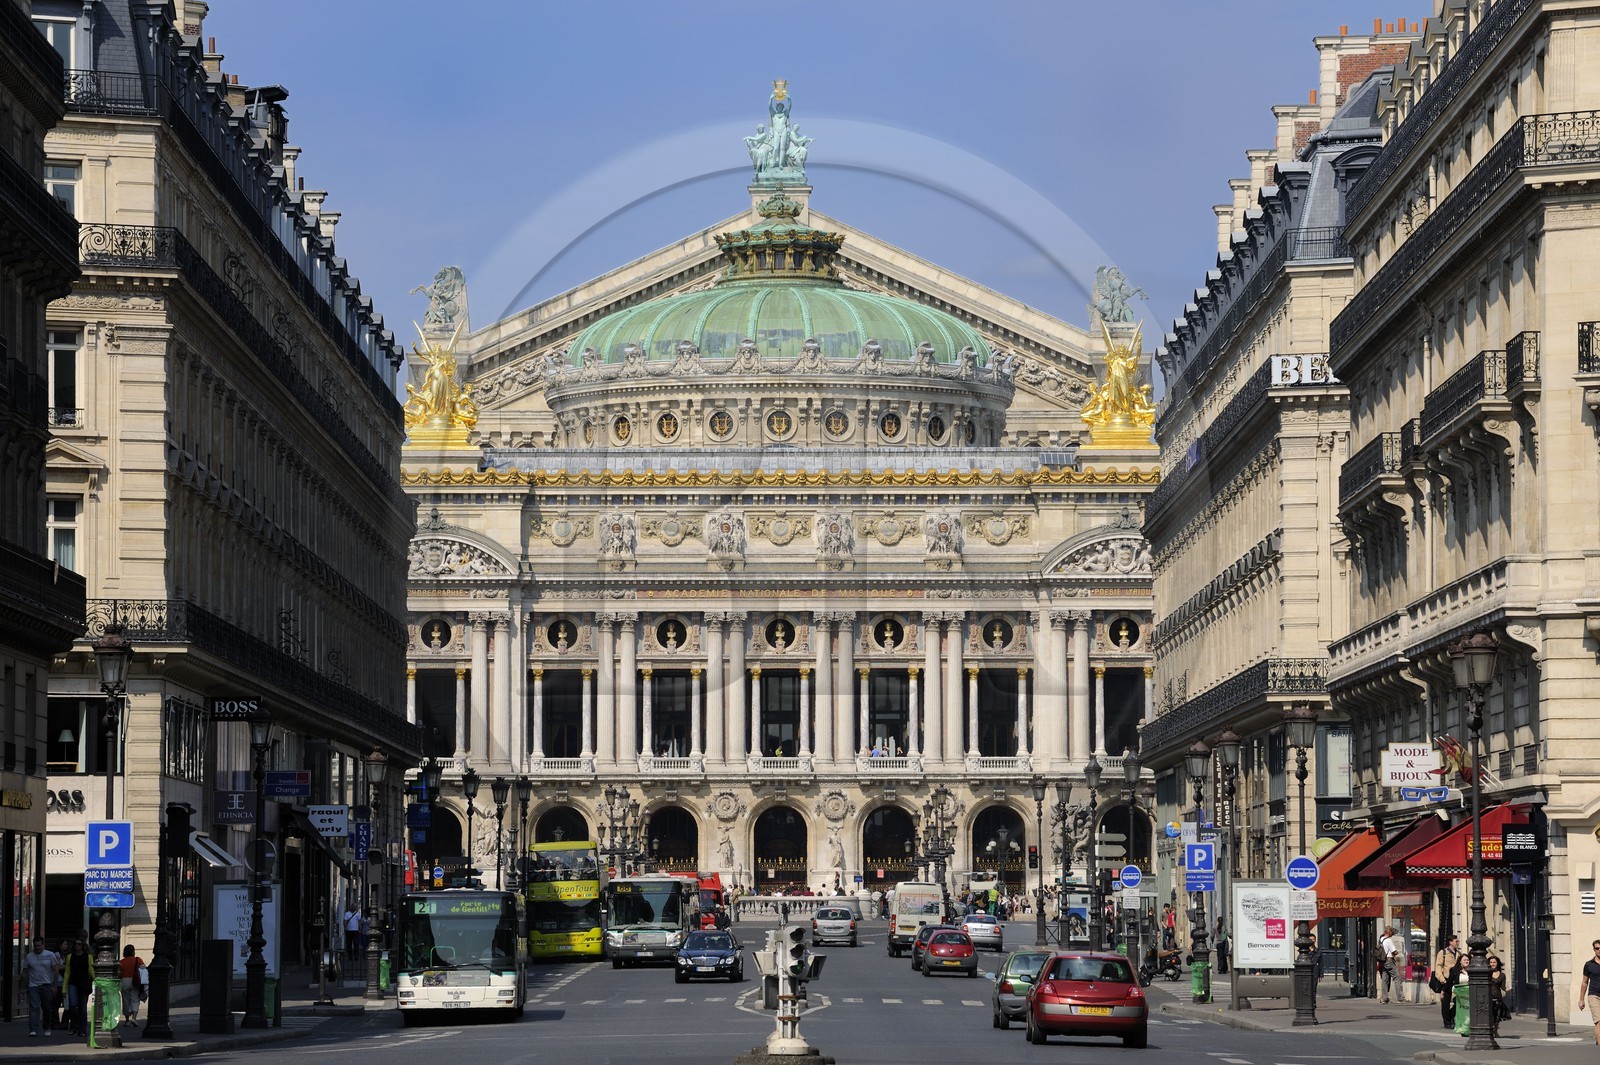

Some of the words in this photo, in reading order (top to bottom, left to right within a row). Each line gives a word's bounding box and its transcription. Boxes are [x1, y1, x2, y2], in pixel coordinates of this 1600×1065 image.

[664, 590, 728, 598] ACADEMIE
[739, 590, 800, 598] NATIONALE
[812, 590, 827, 598] DE
[838, 590, 896, 598] MUSIQUE
[214, 700, 258, 713] BOSS
[1394, 748, 1428, 756] MODE
[1406, 760, 1415, 768] &
[1390, 772, 1432, 782] BIJOUX
[1322, 821, 1352, 830] Café
[98, 830, 120, 858] P
[358, 824, 367, 859] CHANGE
[1194, 849, 1207, 866] P
[86, 870, 100, 878] PARC
[101, 870, 108, 878] DU
[110, 870, 132, 878] MARCHE
[418, 902, 432, 913] 21
[1318, 899, 1371, 911] Breakfast
